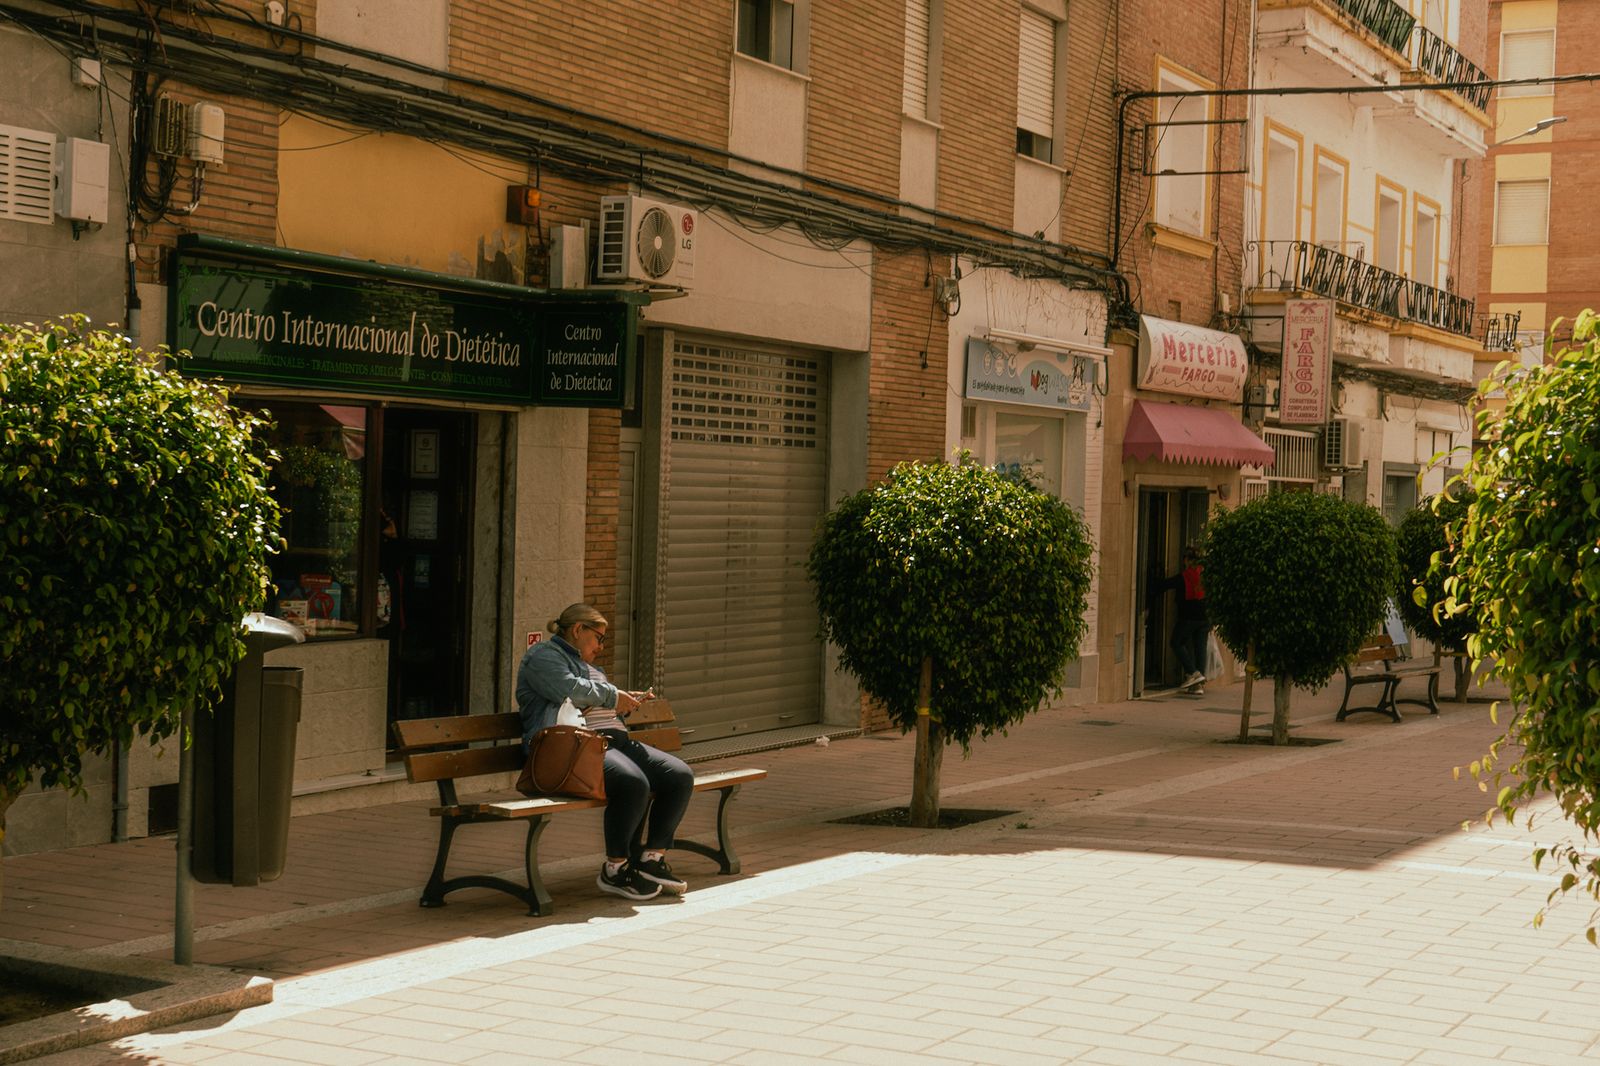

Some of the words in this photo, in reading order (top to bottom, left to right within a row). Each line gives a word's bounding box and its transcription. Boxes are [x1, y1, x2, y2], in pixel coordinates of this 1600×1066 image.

[682, 238, 692, 250] LG
[199, 302, 276, 343] Centro
[282, 311, 416, 357] Internacional
[421, 323, 440, 358] de
[445, 329, 520, 368] Dietética
[564, 324, 602, 341] Centro
[546, 342, 619, 366] Internacional
[1295, 327, 1315, 394] FARGO
[312, 359, 368, 376] TRATAMIENTOS
[1181, 366, 1216, 383] FARGO
[550, 371, 562, 390] de
